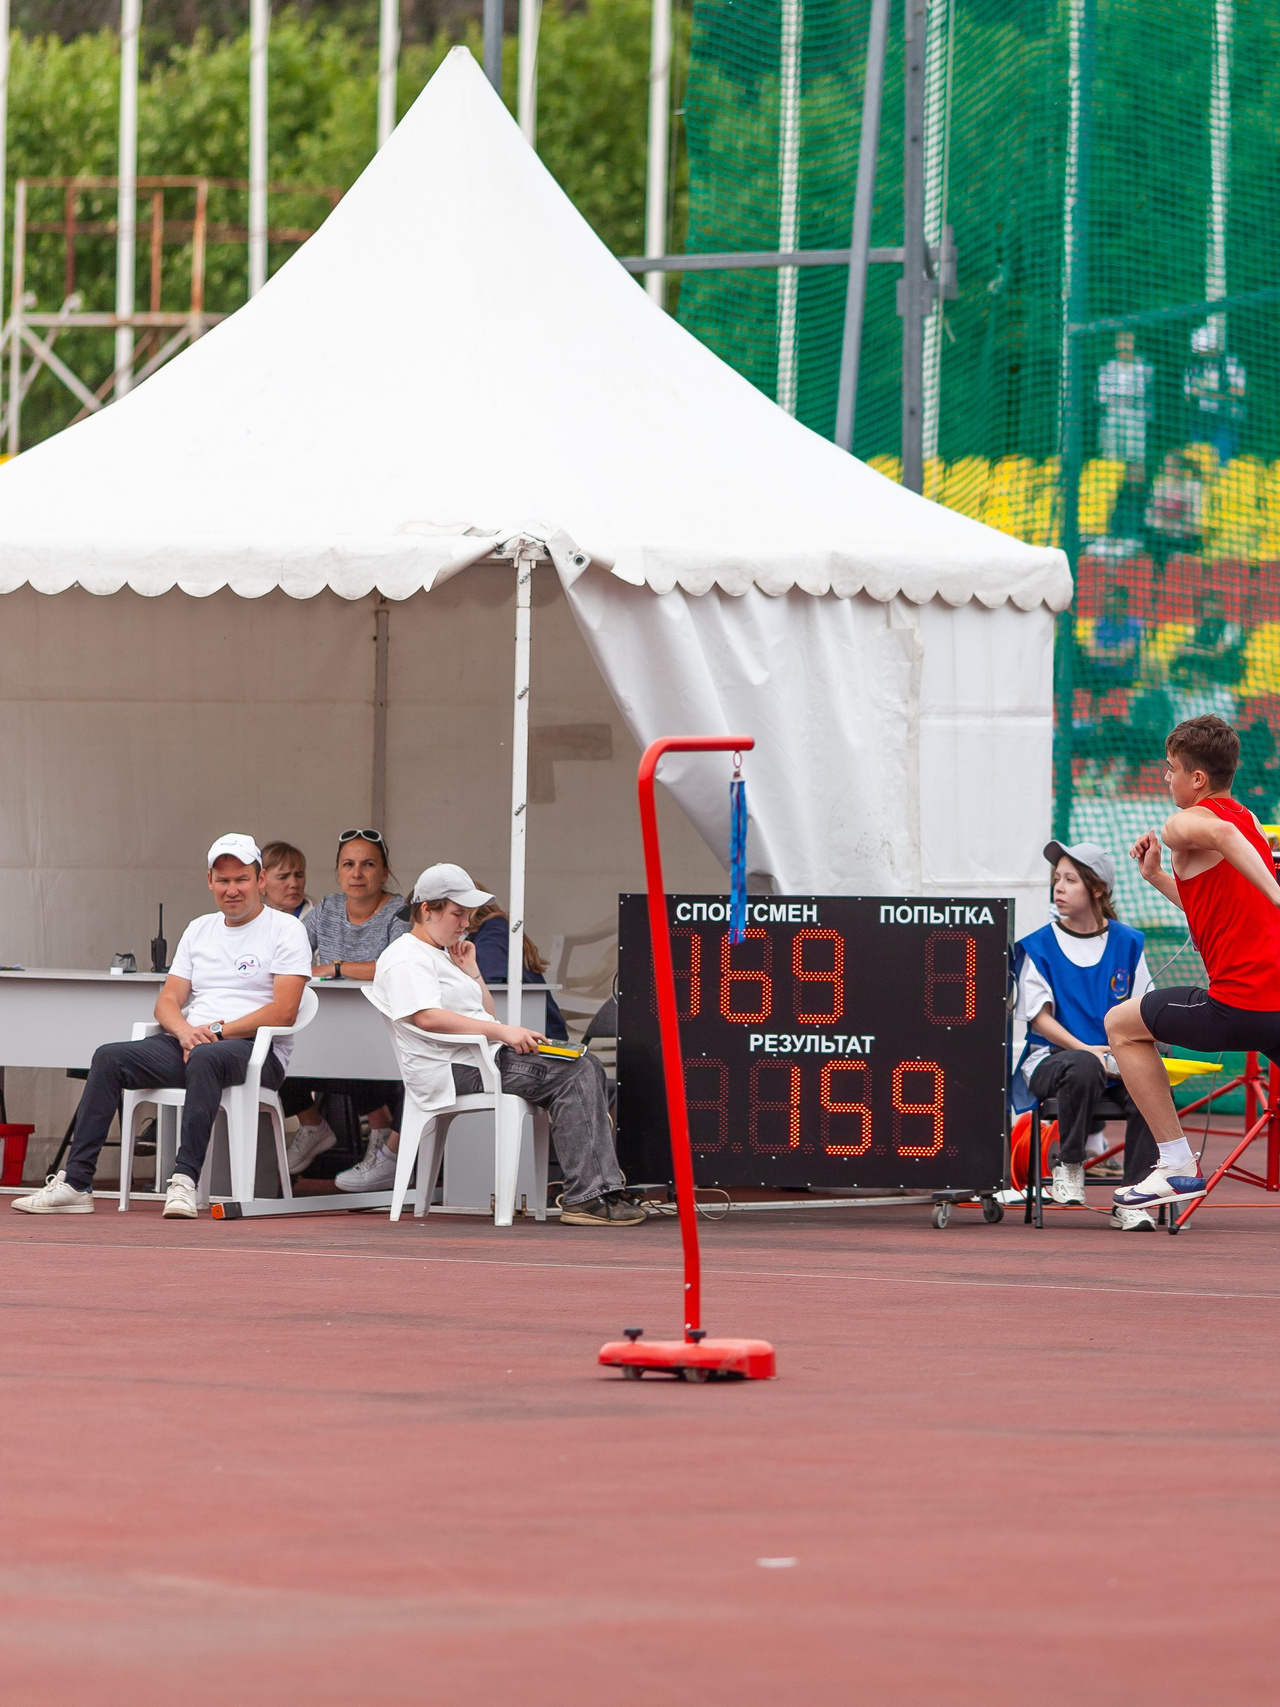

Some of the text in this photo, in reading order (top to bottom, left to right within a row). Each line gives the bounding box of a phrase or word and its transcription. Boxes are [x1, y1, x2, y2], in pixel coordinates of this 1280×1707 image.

[880, 905, 994, 925] ПОПЫТКА
[691, 928, 844, 1024] 169
[749, 1033, 875, 1054] РЕЗУЛЬТАТ
[790, 1060, 944, 1157] 159
